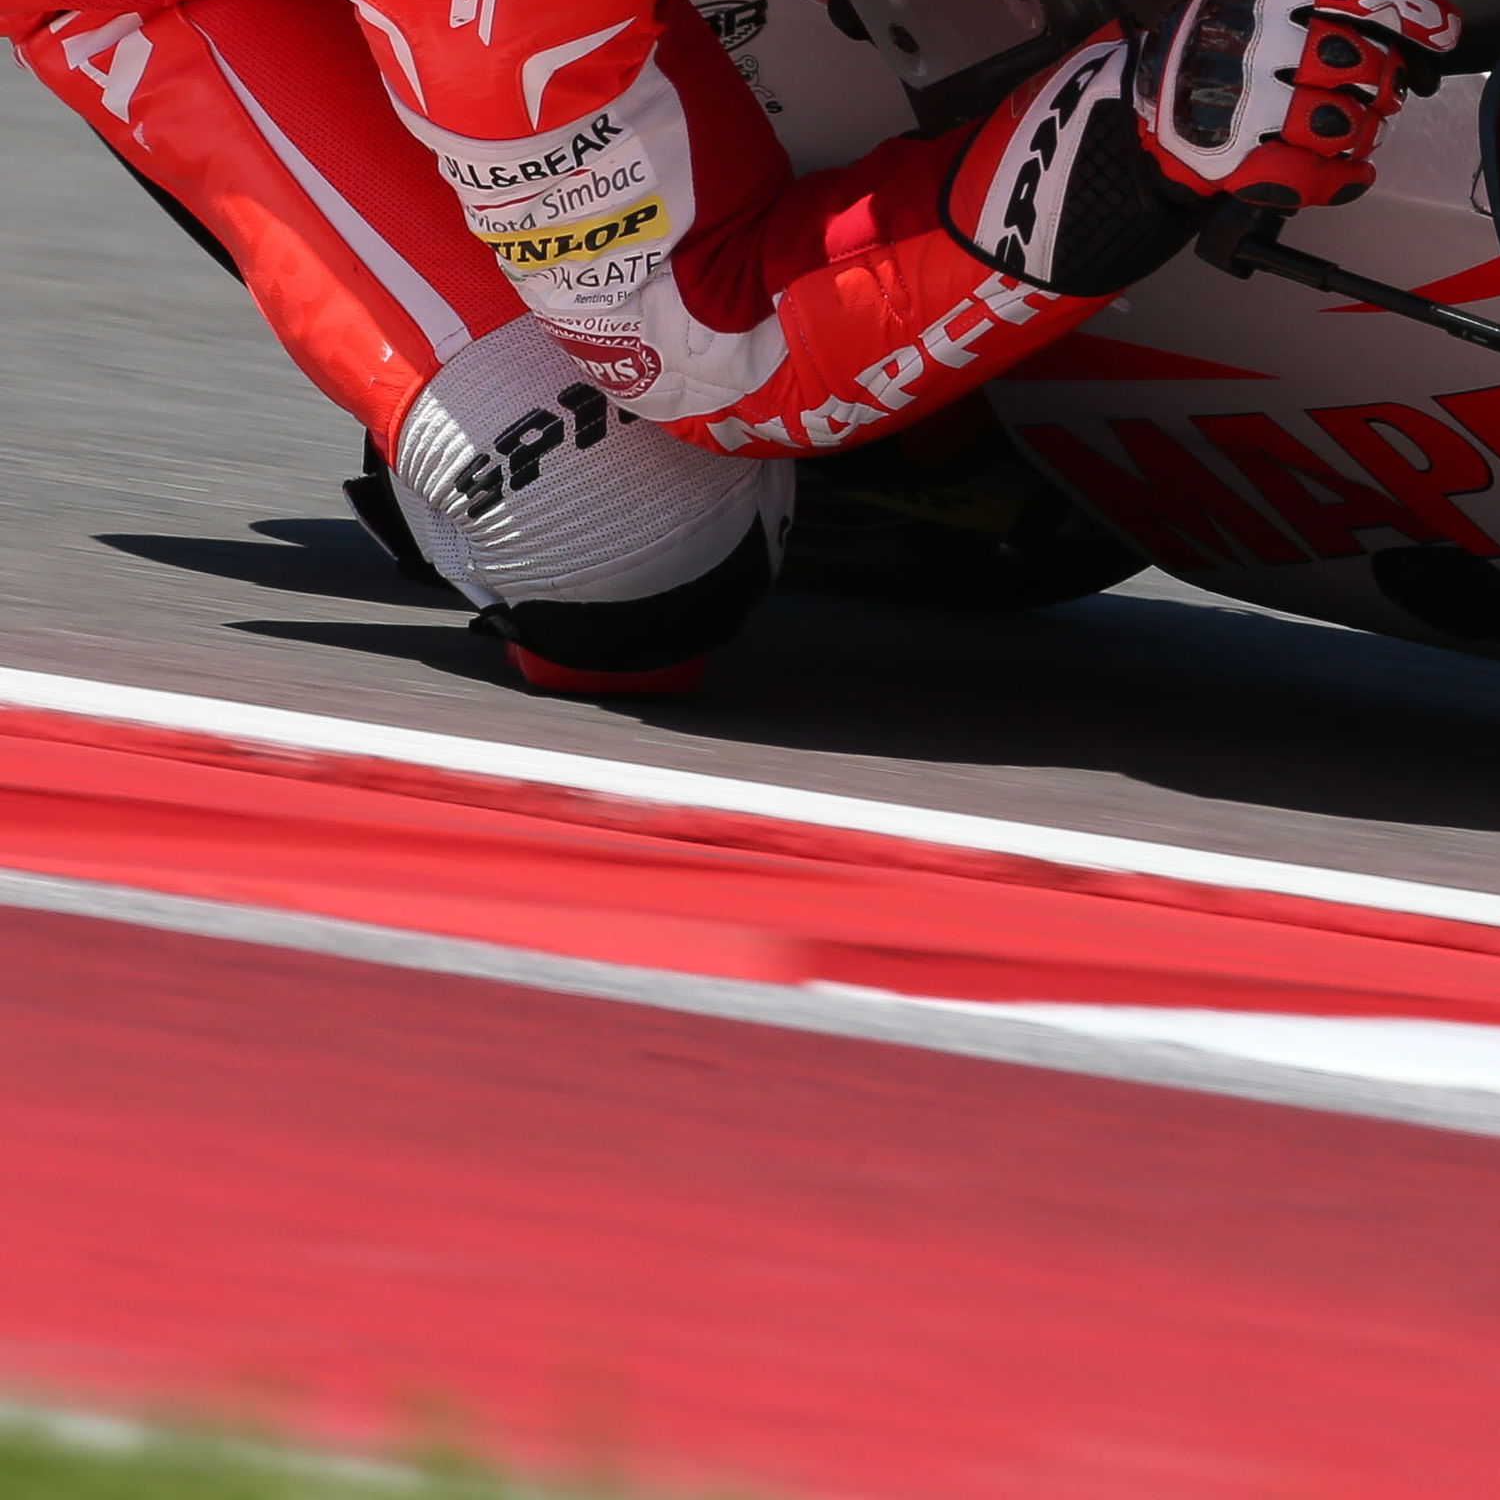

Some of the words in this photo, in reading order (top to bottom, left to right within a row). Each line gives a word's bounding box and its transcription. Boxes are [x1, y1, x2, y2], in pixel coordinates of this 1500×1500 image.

[445, 113, 624, 191] ULL&BEAR
[542, 161, 646, 220] Simbac
[705, 271, 1062, 452] MAPFR
[455, 381, 640, 519] SPI
